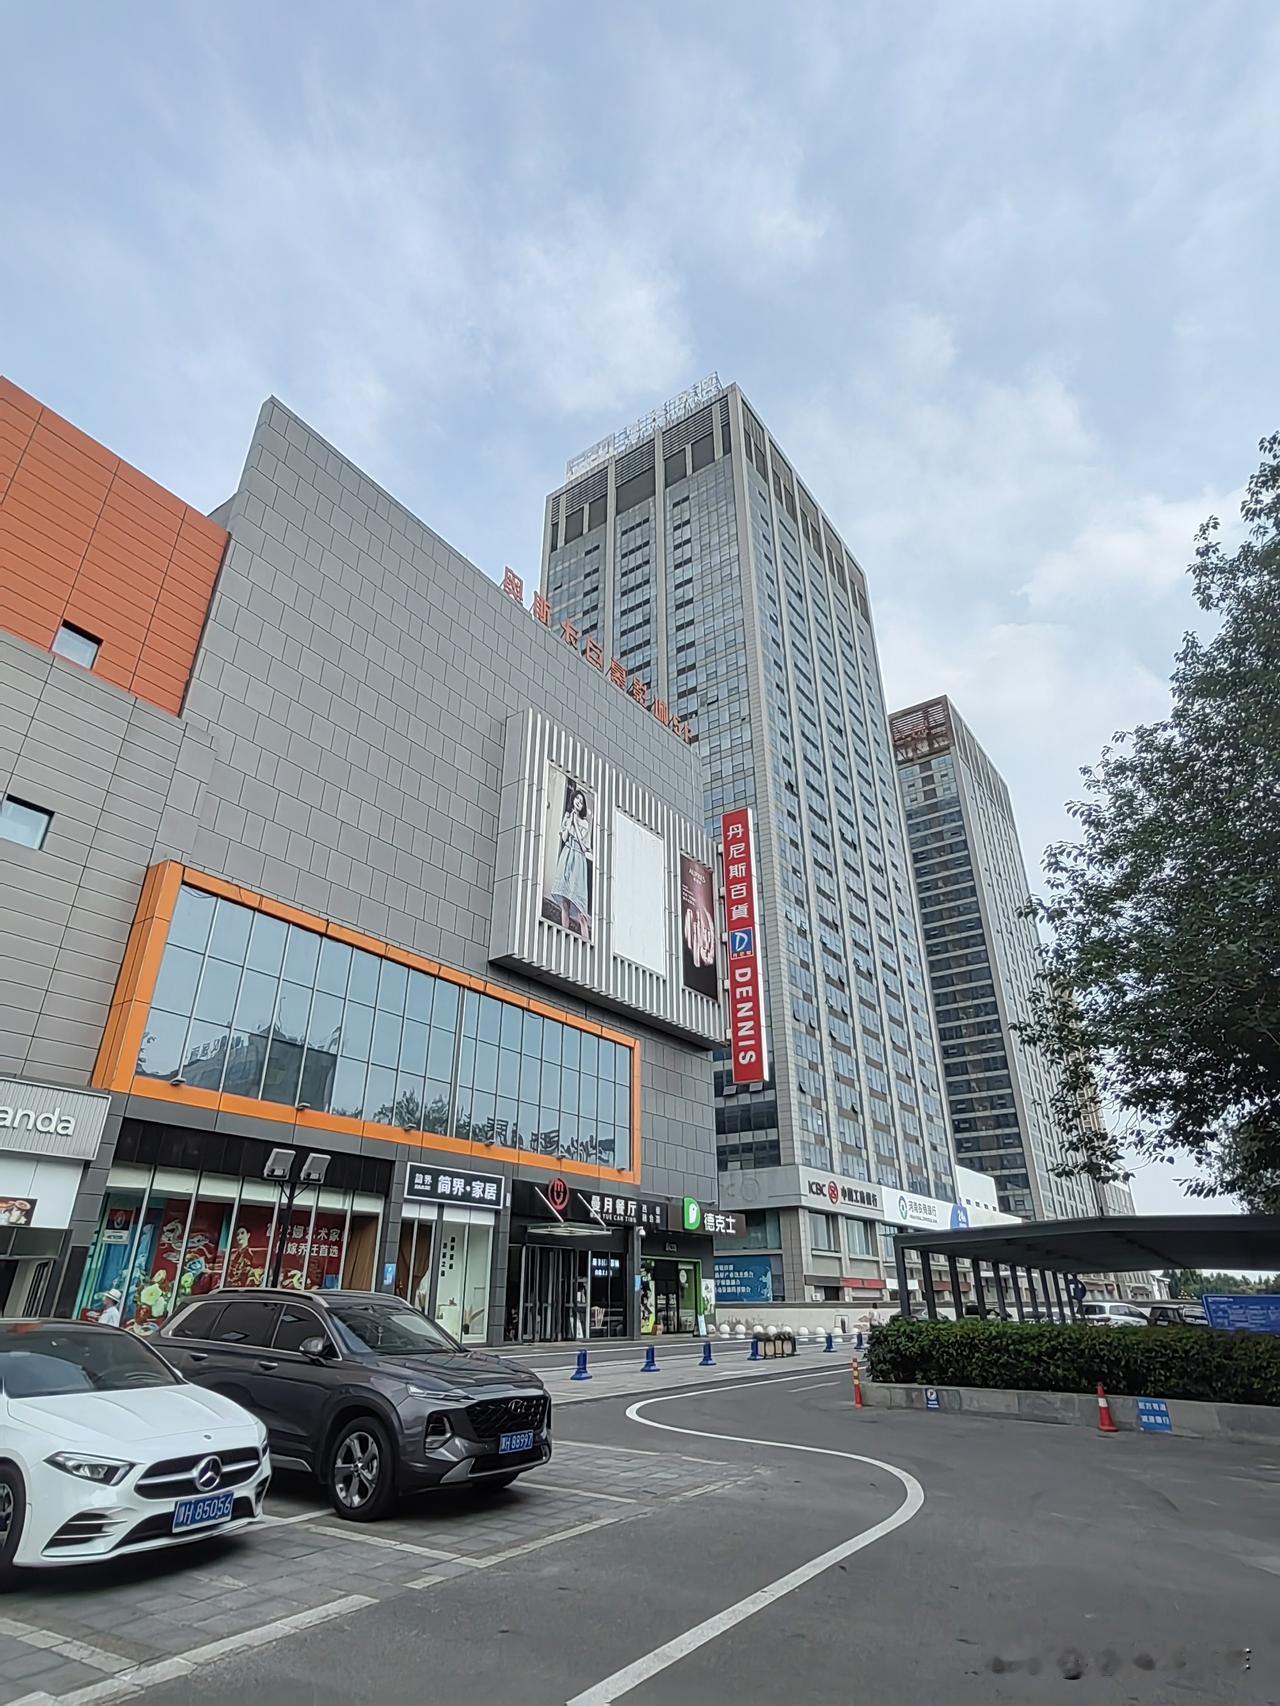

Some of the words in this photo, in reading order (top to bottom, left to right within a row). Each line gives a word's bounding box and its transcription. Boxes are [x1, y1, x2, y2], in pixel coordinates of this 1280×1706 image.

[735, 967, 756, 1065] DENNIS
[437, 1175, 497, 1201] 简界·家居
[807, 1180, 827, 1197] ICBC
[703, 1212, 736, 1234] 德克士
